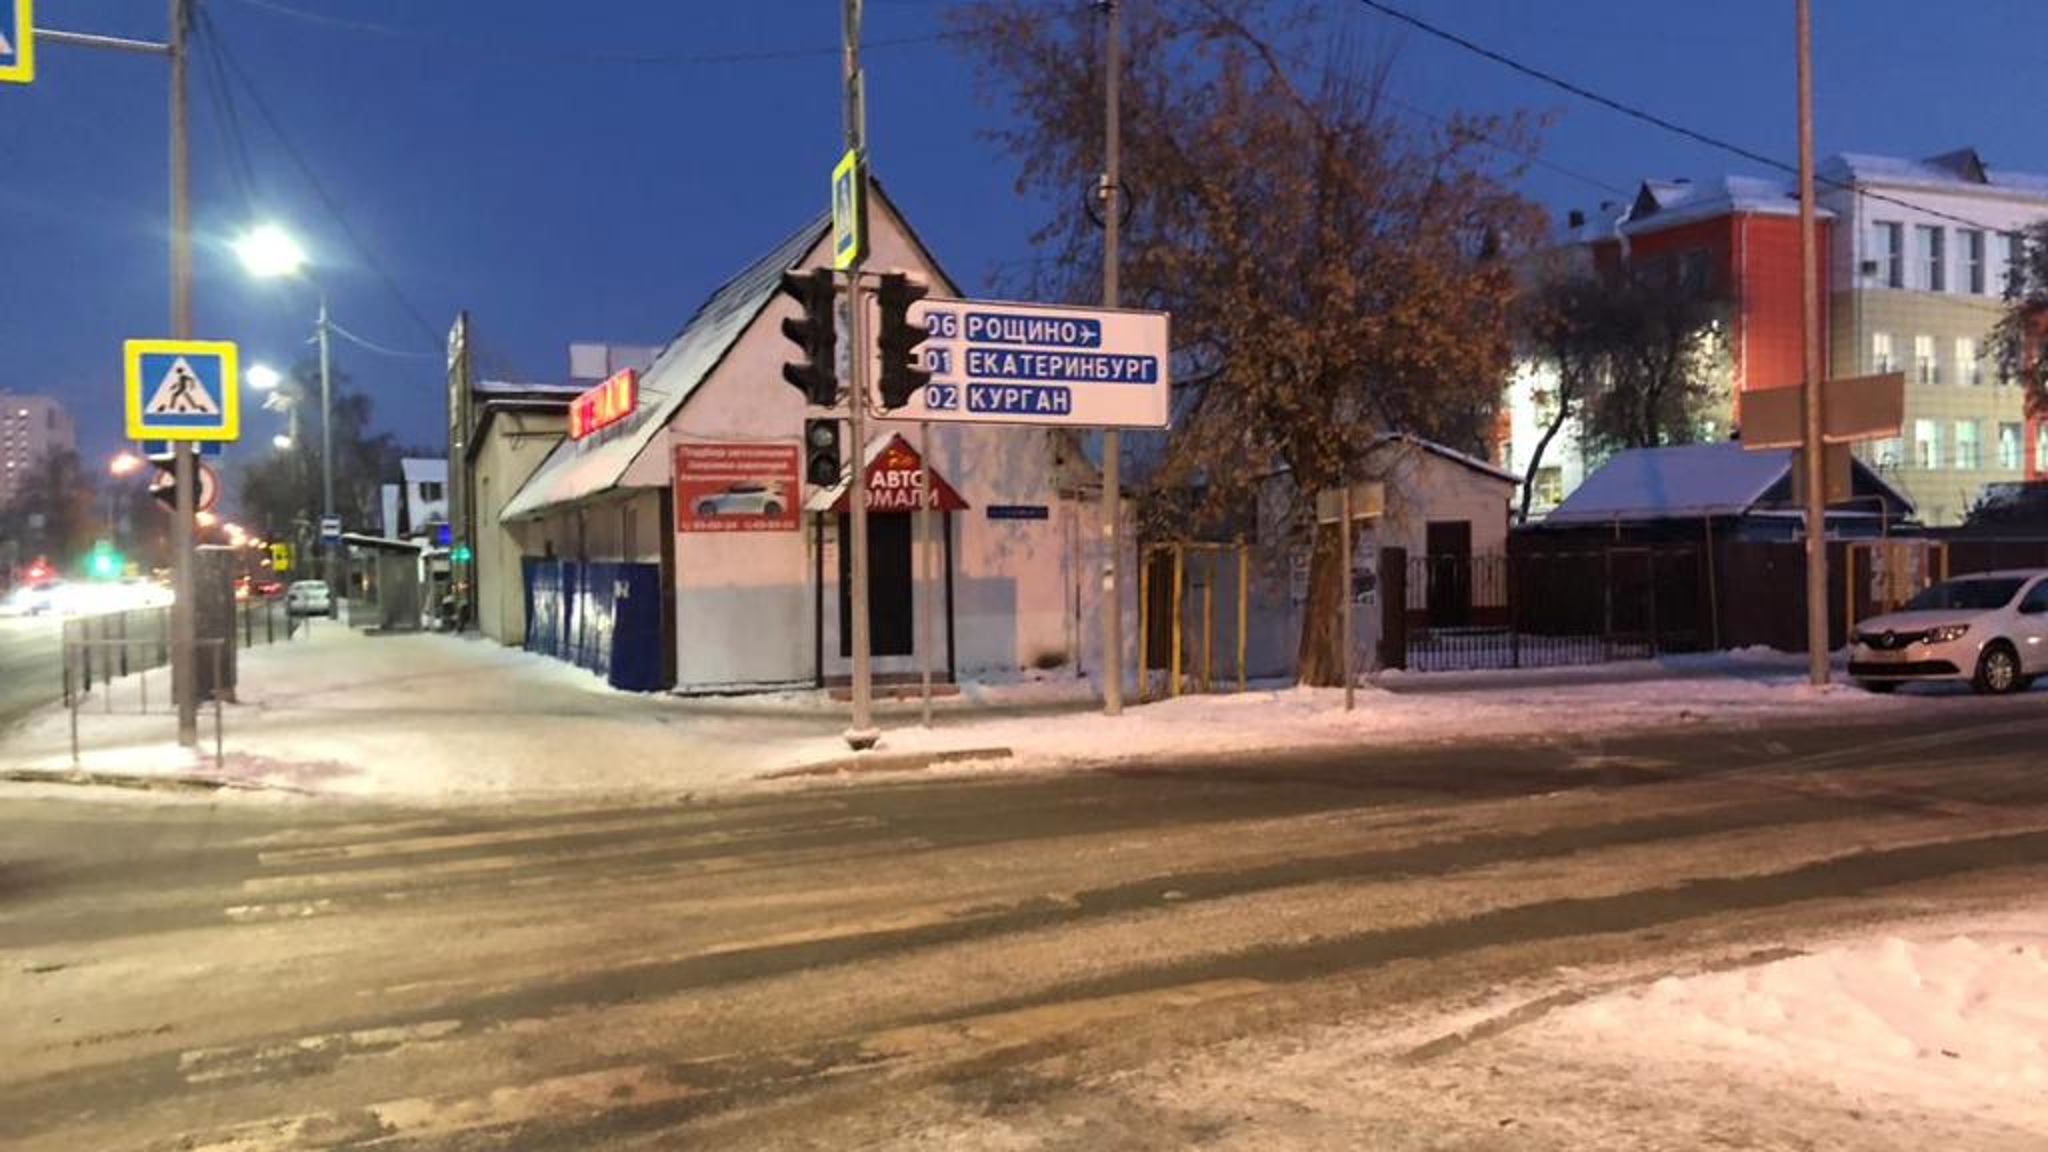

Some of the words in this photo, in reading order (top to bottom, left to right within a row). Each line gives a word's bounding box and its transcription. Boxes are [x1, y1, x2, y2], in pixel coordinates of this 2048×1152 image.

[968, 317, 1076, 345] РОЩИНО
[969, 351, 1154, 380] ЕКАТЕРИНБУРГ
[926, 386, 956, 408] 02
[970, 387, 1068, 411] КУРГАН
